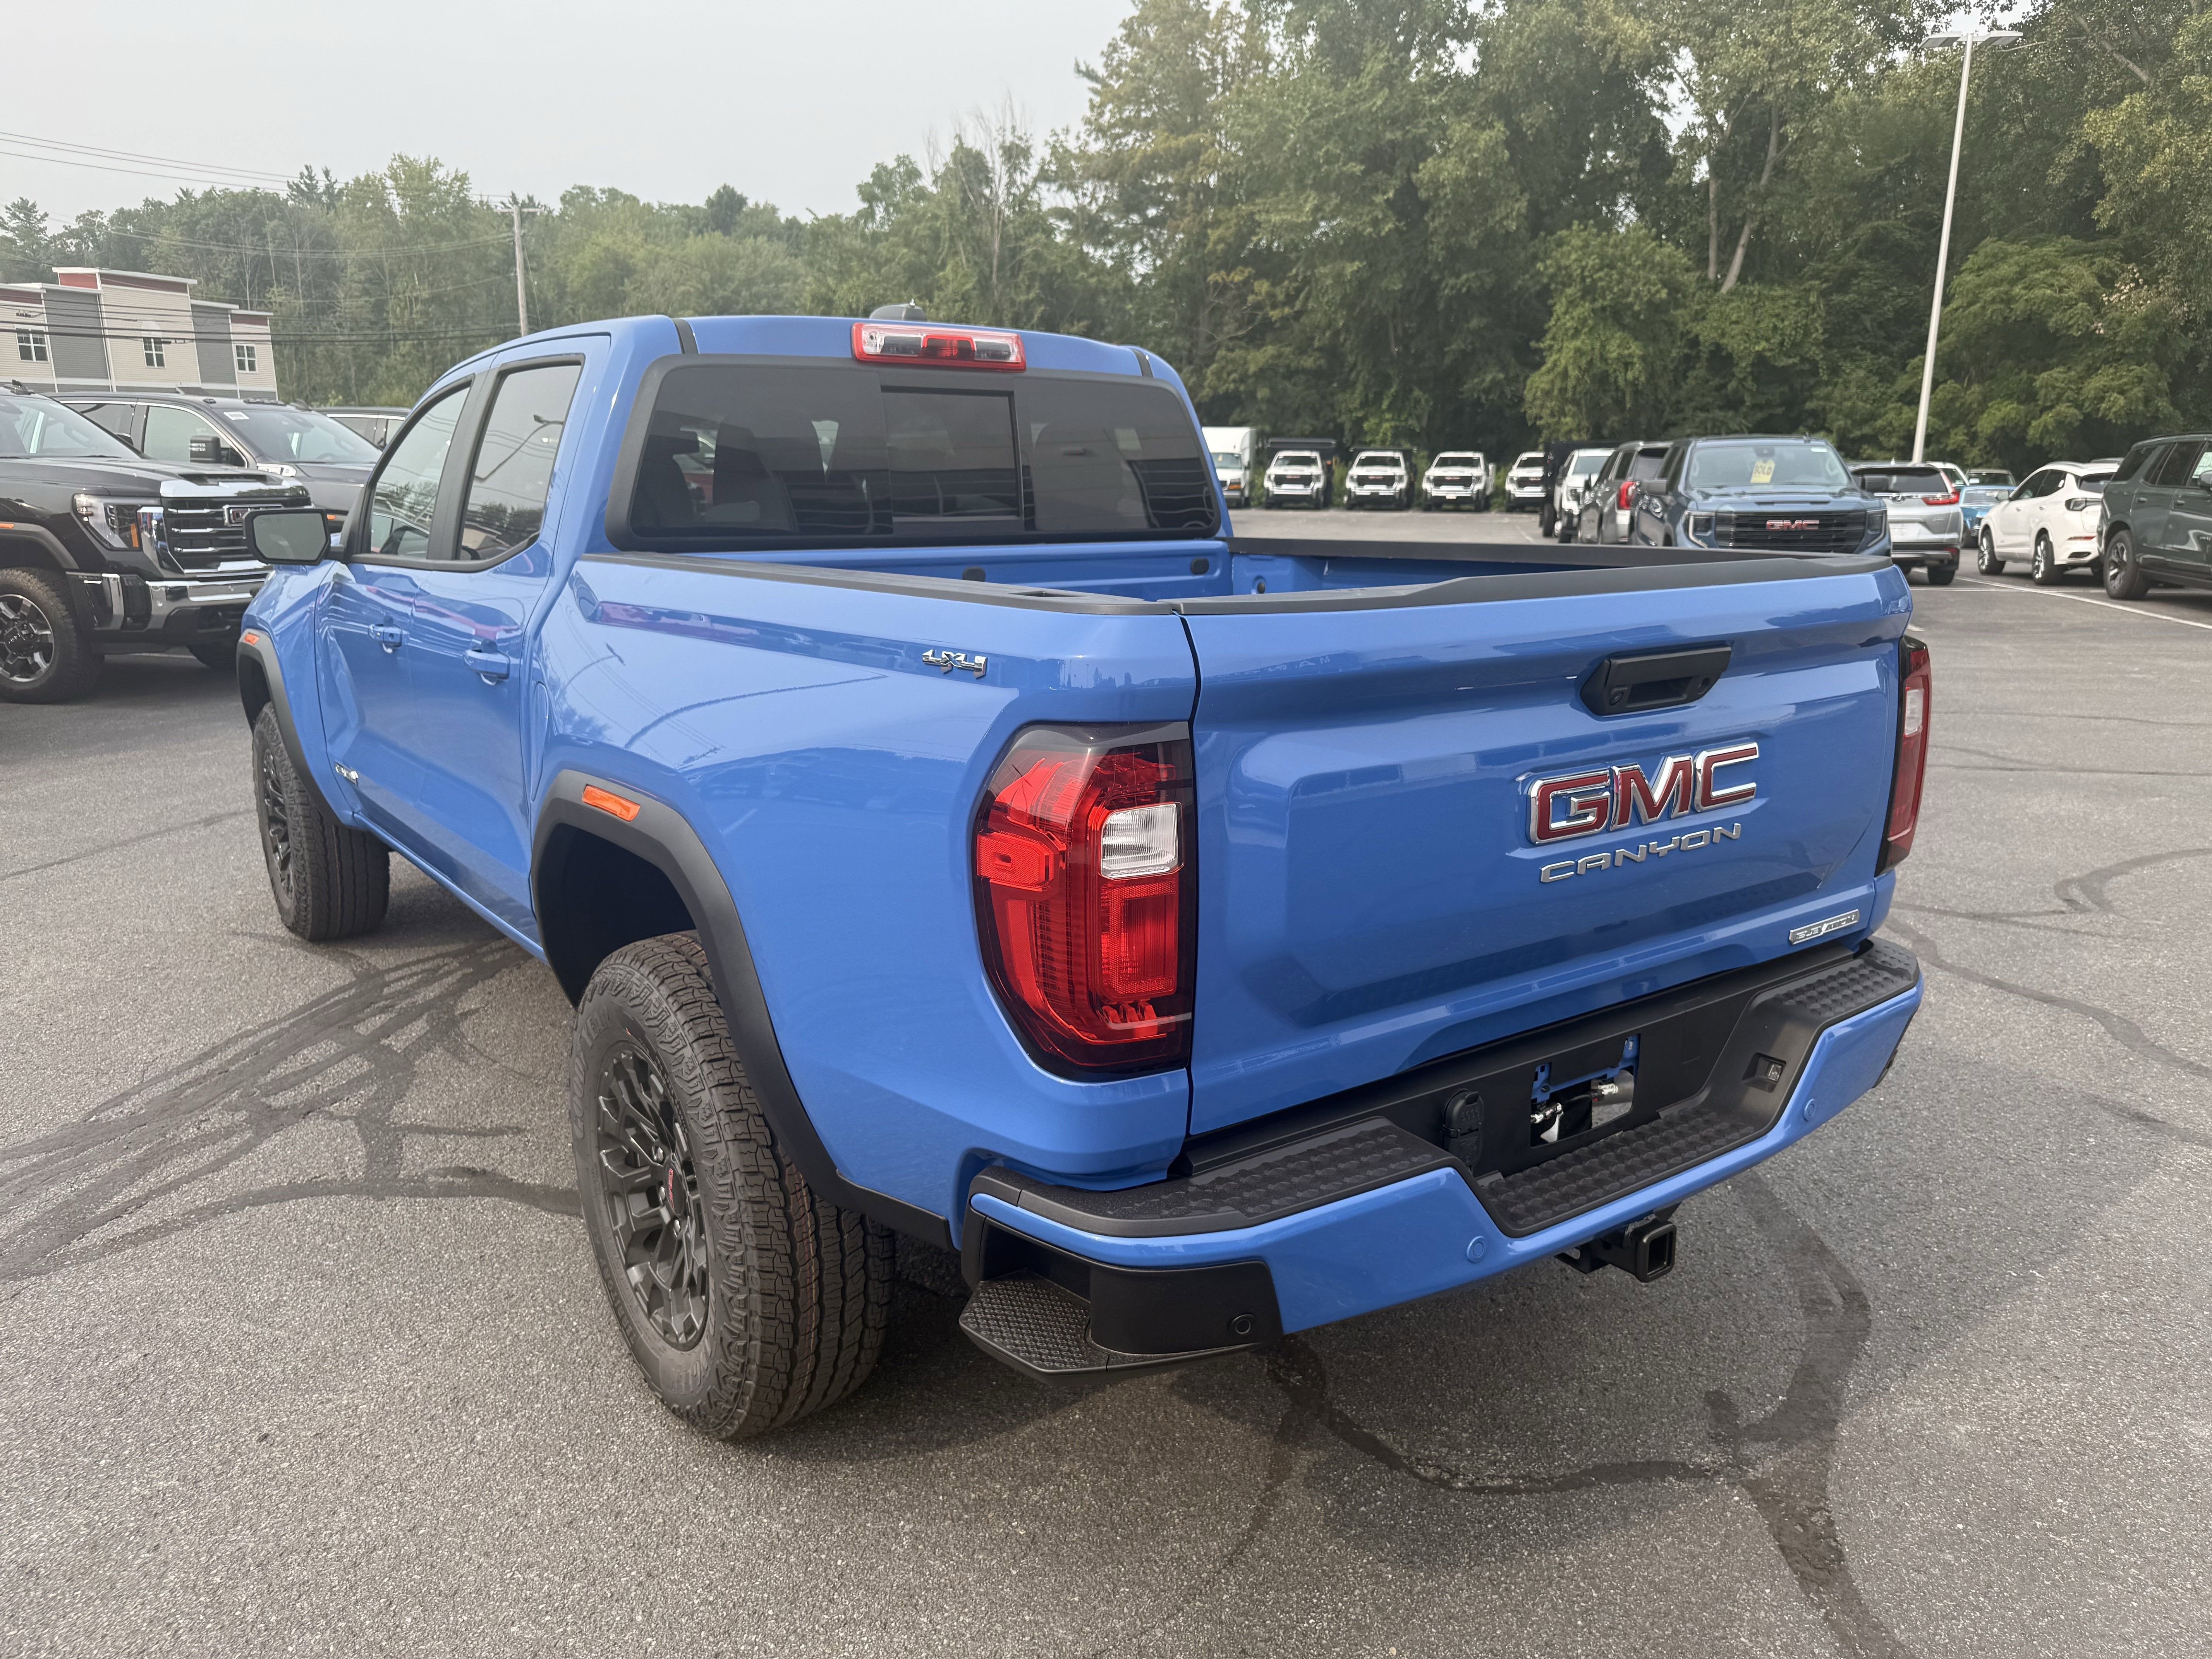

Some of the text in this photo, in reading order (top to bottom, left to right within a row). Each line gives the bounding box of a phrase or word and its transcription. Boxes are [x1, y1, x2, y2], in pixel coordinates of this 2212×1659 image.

[1766, 520, 1819, 531] GMC
[1527, 742, 1759, 845] GMC
[1540, 823, 1741, 883] CANYON
